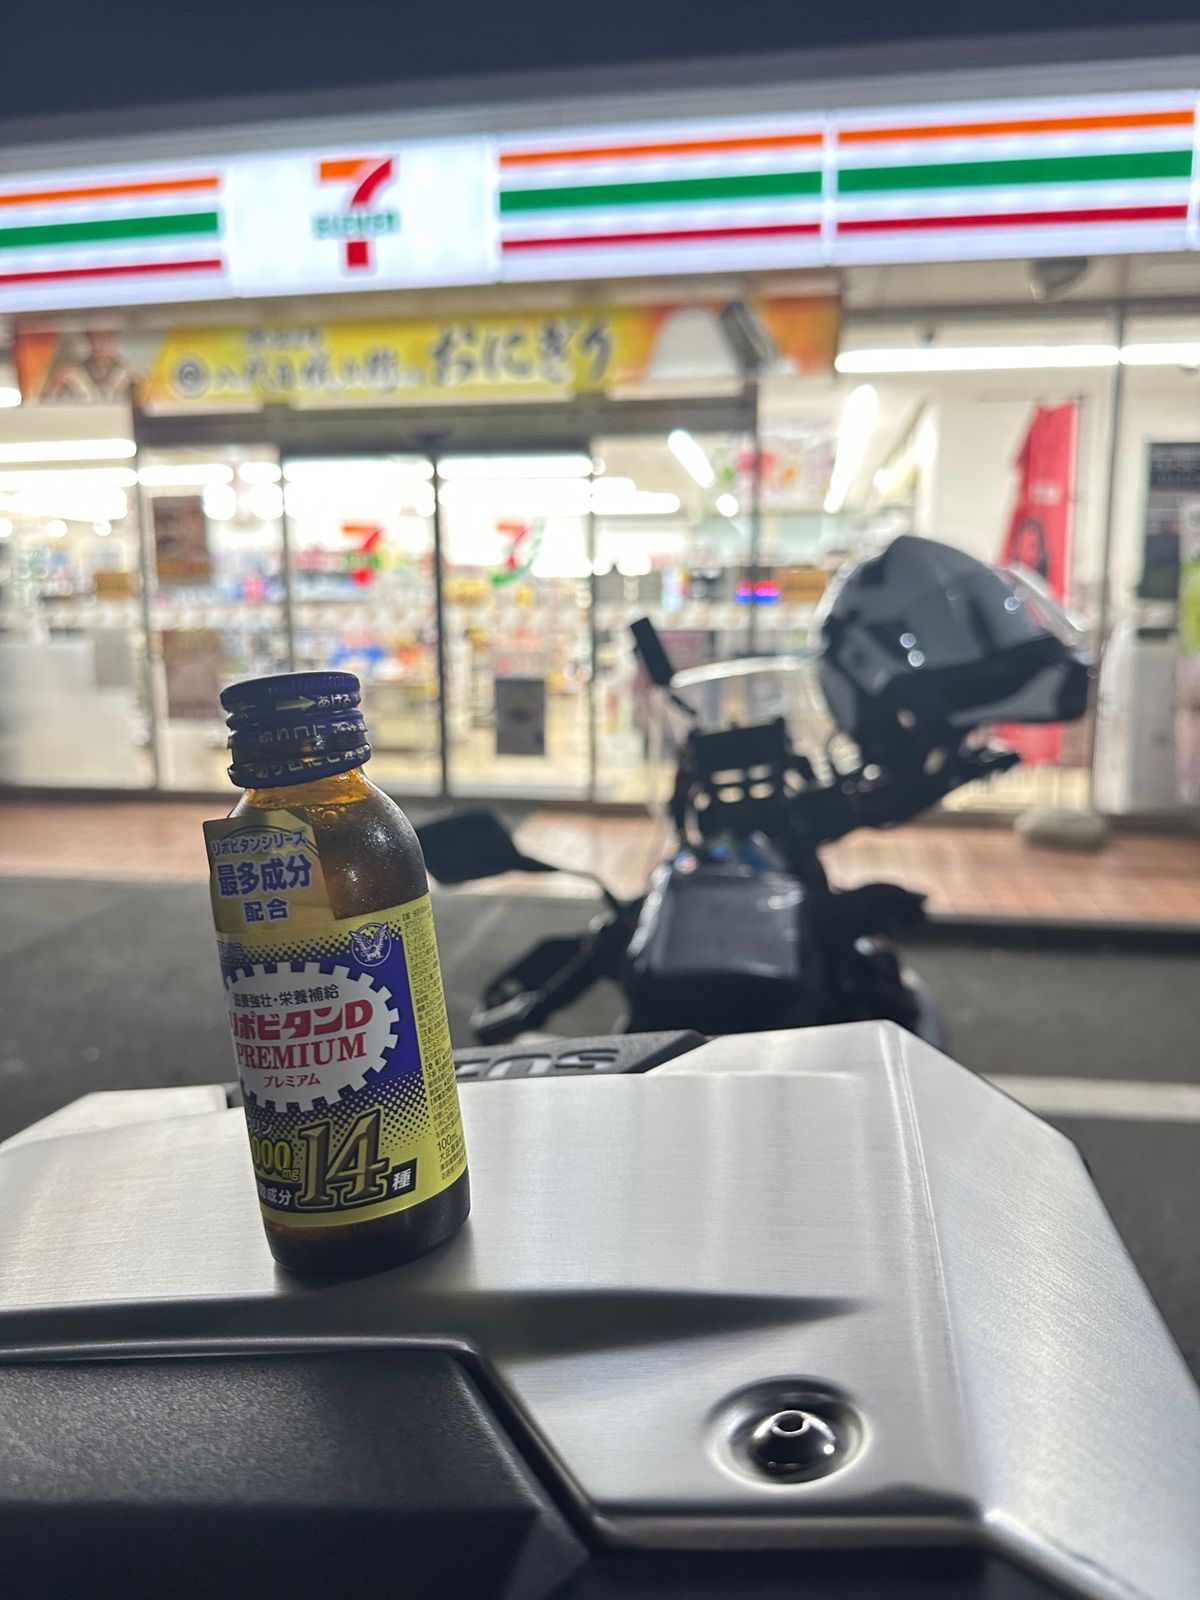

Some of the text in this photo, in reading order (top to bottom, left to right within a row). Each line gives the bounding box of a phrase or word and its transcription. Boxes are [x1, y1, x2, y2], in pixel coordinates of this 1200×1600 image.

[318, 158, 394, 270] 7
[216, 853, 312, 897] 最多成分
[243, 898, 288, 922] 配合
[235, 1031, 367, 1070] PREMIUM
[264, 1072, 321, 1088] プレミアム
[298, 1104, 391, 1208] 14
[392, 1168, 412, 1191] 種
